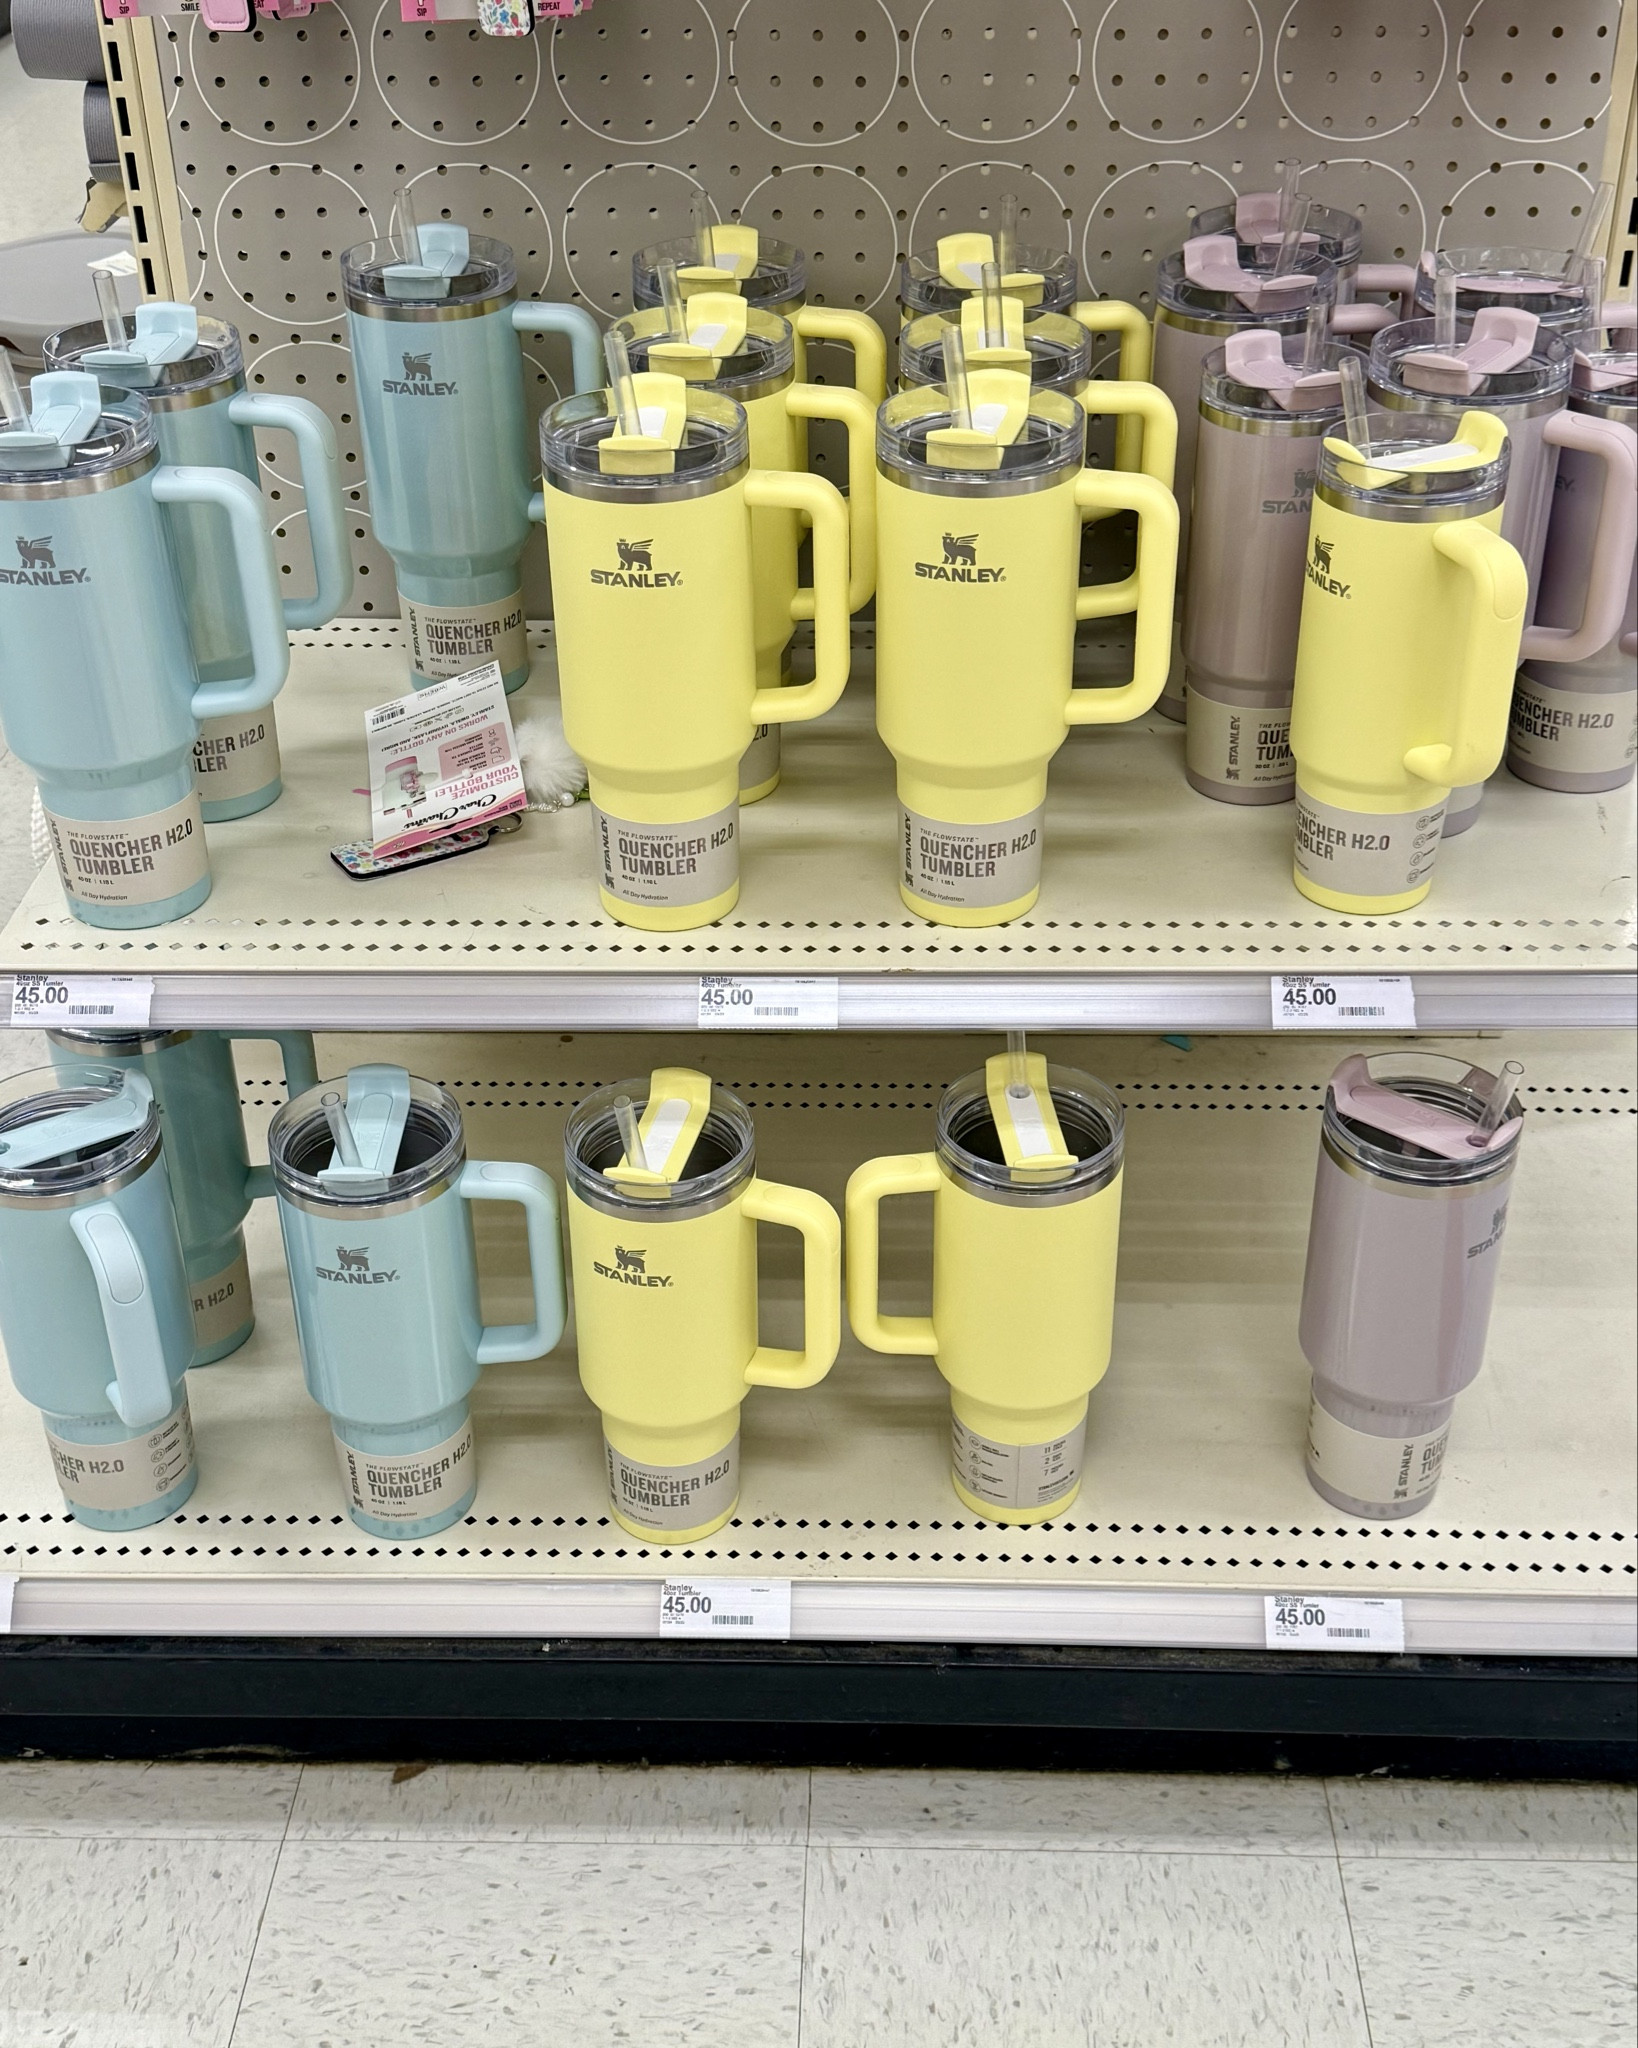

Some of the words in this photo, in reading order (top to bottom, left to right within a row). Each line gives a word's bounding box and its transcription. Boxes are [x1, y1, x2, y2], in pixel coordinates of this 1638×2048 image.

[119, 6, 130, 15] SIP
[181, 3, 200, 12] SMILE
[416, 7, 427, 17] SIP
[537, 2, 560, 11] REPEAT
[382, 379, 458, 396] STANLEY
[1261, 500, 1312, 514] STAN
[408, 606, 421, 657] STANLEY
[425, 620, 501, 640] QUENCHER
[503, 608, 522, 631] H2.0
[427, 638, 493, 656] TUMBLER
[459, 714, 489, 731] WORKS
[1577, 713, 1614, 729] H2.0
[193, 736, 236, 757] CHER
[239, 723, 265, 748] H2.0
[425, 731, 443, 743] ANY
[445, 727, 457, 736] ON
[1229, 714, 1241, 765] STANLEY
[486, 764, 518, 780] YOUR
[434, 775, 483, 798] BOTTLE!
[452, 771, 519, 801] CUSTOMIZE
[69, 834, 163, 858] QUENCHER
[165, 818, 193, 846] H2.0
[600, 815, 612, 873] STANLEY
[617, 829, 629, 838] THE
[631, 833, 674, 841] FLOWSTATE
[618, 837, 707, 859] QUENCHER
[710, 822, 734, 850] H2.0
[904, 812, 912, 871] STANLEY
[920, 828, 931, 836] THE
[933, 832, 975, 843] FLOWSTATE
[1351, 833, 1390, 851] H2.0
[920, 836, 1007, 861] QUENCHER
[1011, 828, 1037, 854] H2.0
[73, 855, 155, 876] TUMBLER
[619, 854, 697, 876] TUMBLER
[920, 853, 996, 878] TUMBLER
[99, 893, 128, 901] Hydration
[640, 893, 669, 901] Hydration
[937, 893, 965, 902] Hydration
[1282, 975, 1314, 984] Stanley
[15, 986, 69, 1004] 45.00
[701, 988, 753, 1006] 45.00
[1282, 988, 1337, 1005] 45.00
[1467, 1227, 1503, 1259] STAN
[207, 1282, 234, 1307] H2.0
[88, 1459, 125, 1474] H2.0
[367, 1457, 450, 1485] QUENCHER
[453, 1433, 472, 1465] H2.0
[620, 1462, 629, 1471] THE
[1398, 1443, 1414, 1487] STANLEY
[346, 1450, 361, 1496] STANLEY
[620, 1468, 701, 1494] QUENCHER
[704, 1459, 730, 1486] H2.0
[368, 1476, 442, 1499] TUMBLER
[621, 1481, 690, 1507] TUMBLER
[663, 1583, 693, 1592] Stanley
[663, 1596, 712, 1613] 45.00
[1275, 1595, 1305, 1604] Stanley
[1275, 1608, 1326, 1626] 45.00
